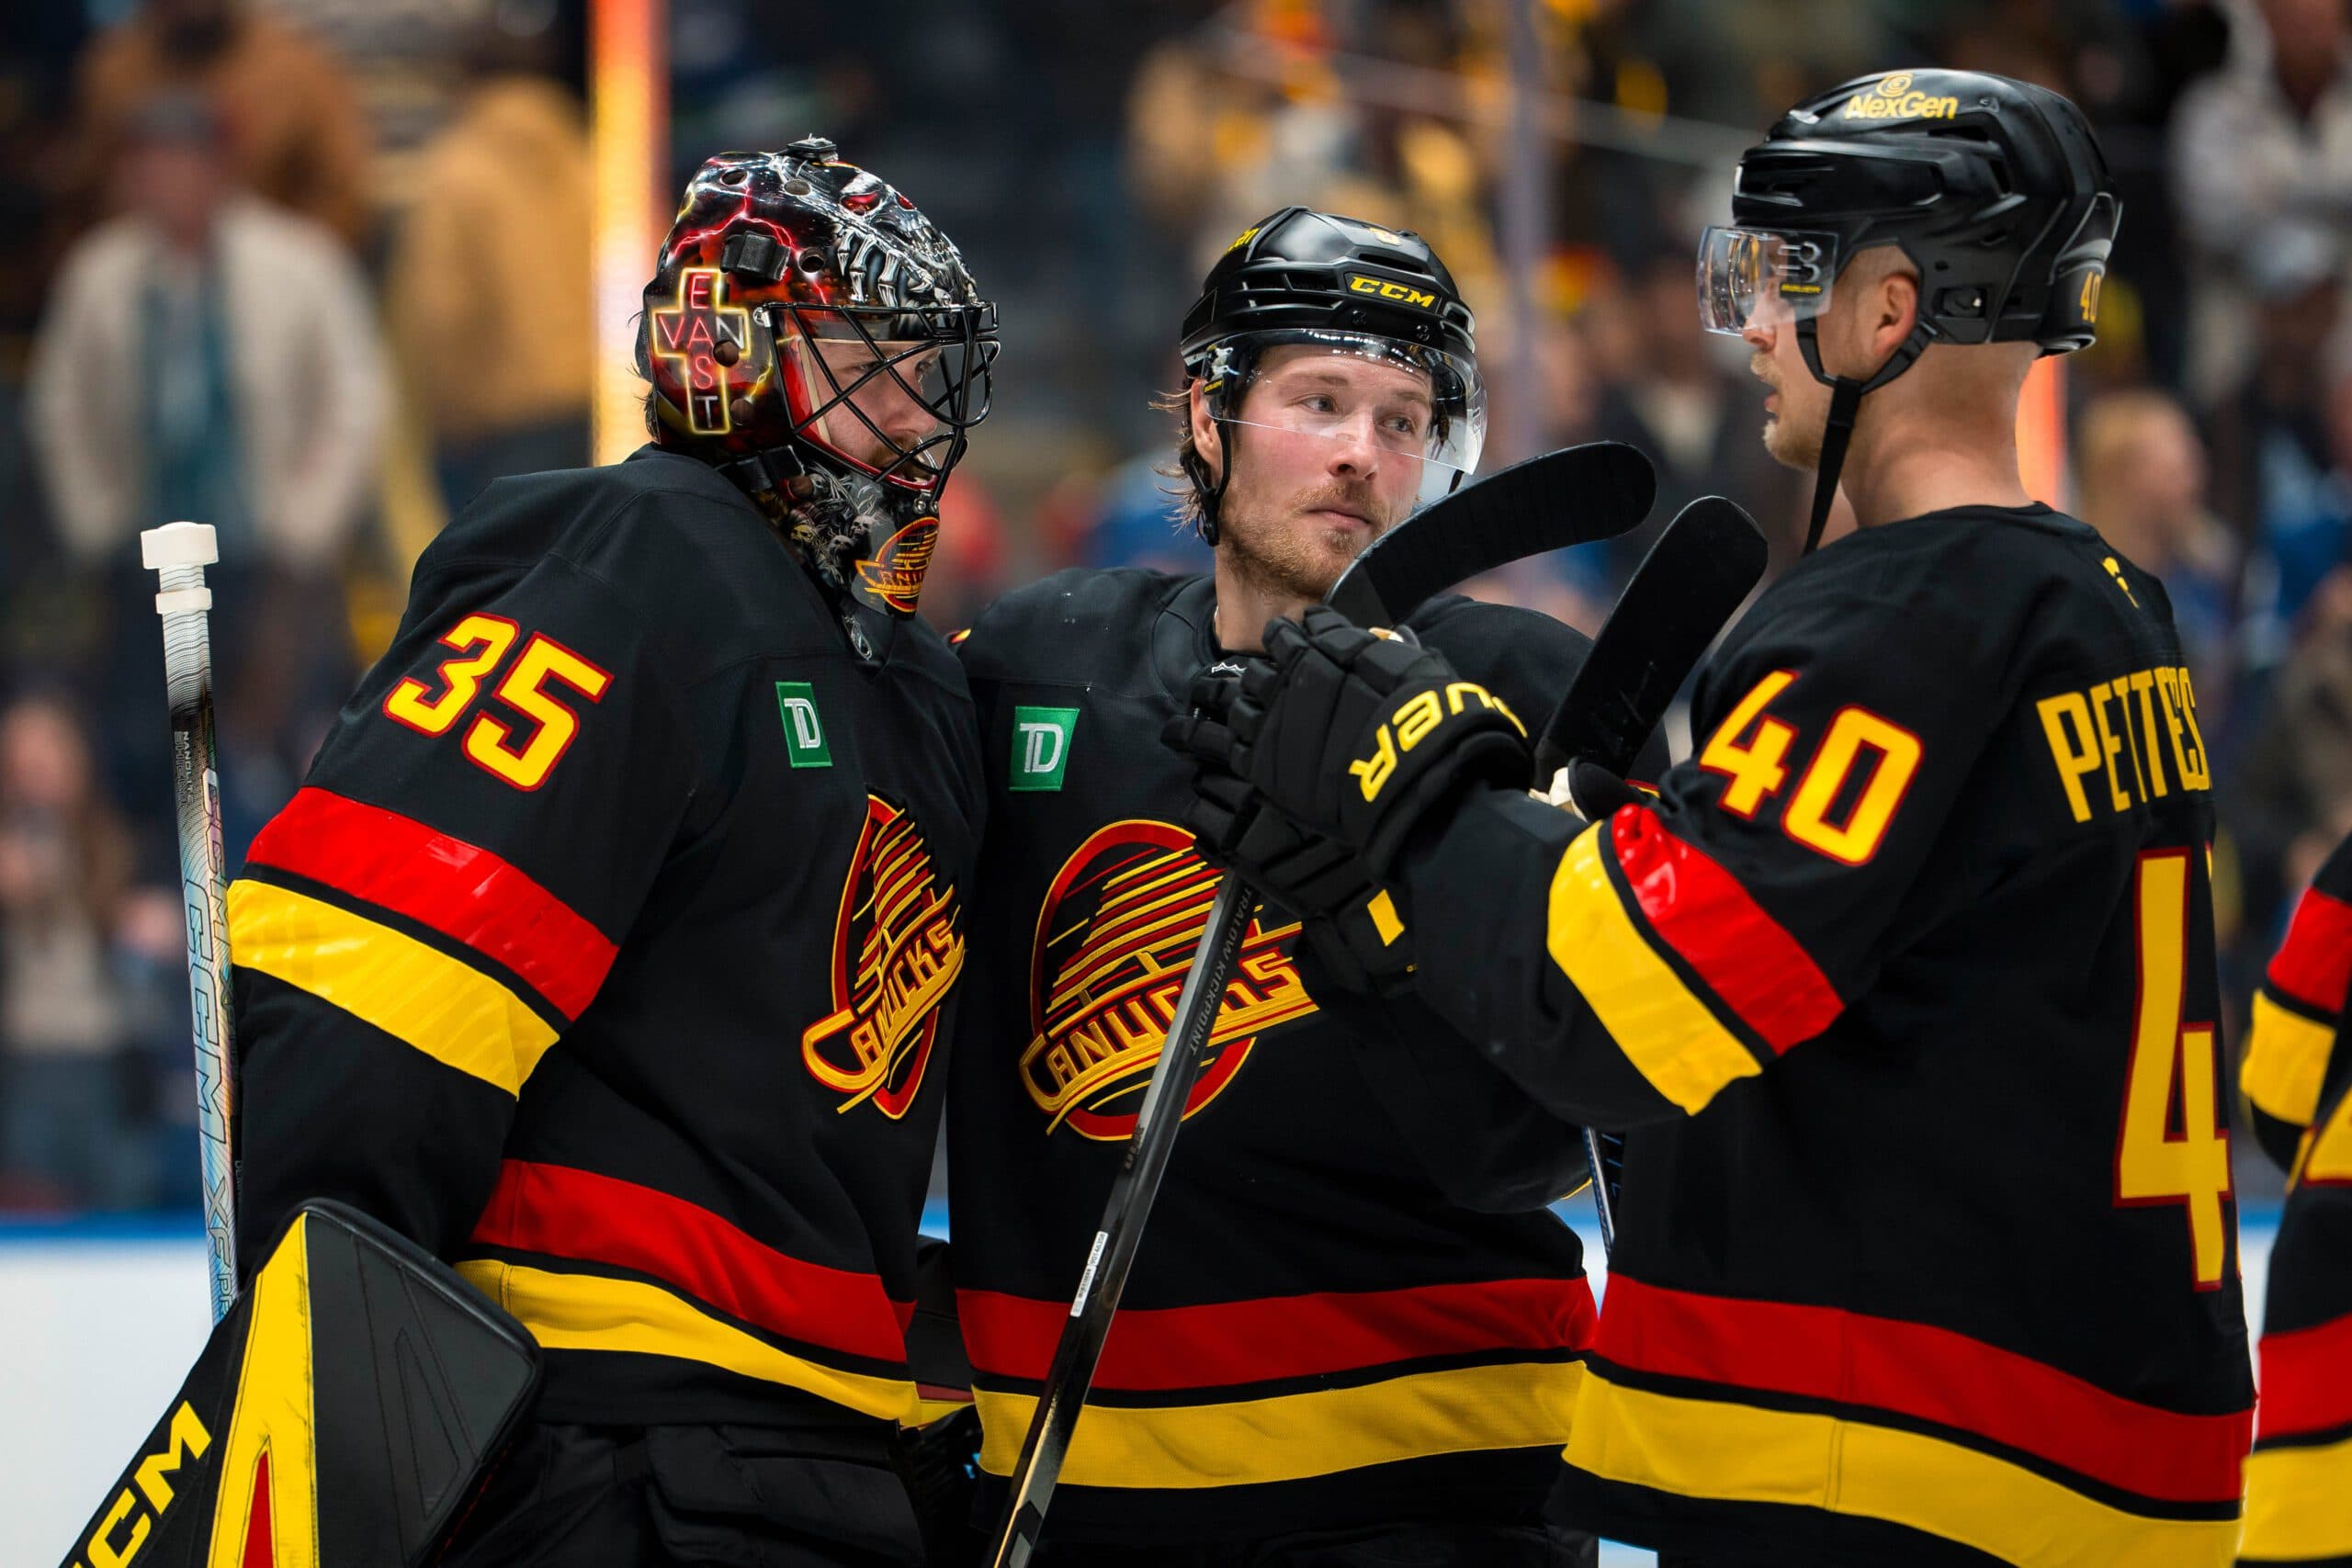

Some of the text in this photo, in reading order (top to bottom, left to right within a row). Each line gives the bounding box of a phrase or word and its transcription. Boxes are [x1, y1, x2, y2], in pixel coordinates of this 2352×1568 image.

[1844, 90, 1959, 120] NexGen
[1348, 276, 1435, 309] CCM
[2080, 271, 2101, 323] 40
[383, 611, 615, 792] 35
[784, 698, 820, 749] TD
[1019, 723, 1063, 773] TD
[1699, 668, 1924, 866] 40
[183, 879, 226, 1145] CCM
[1189, 961, 1227, 1056] KICKPOINT
[2113, 846, 2242, 1292] 4
[216, 1272, 234, 1316] PR
[73, 1400, 212, 1568] CM
